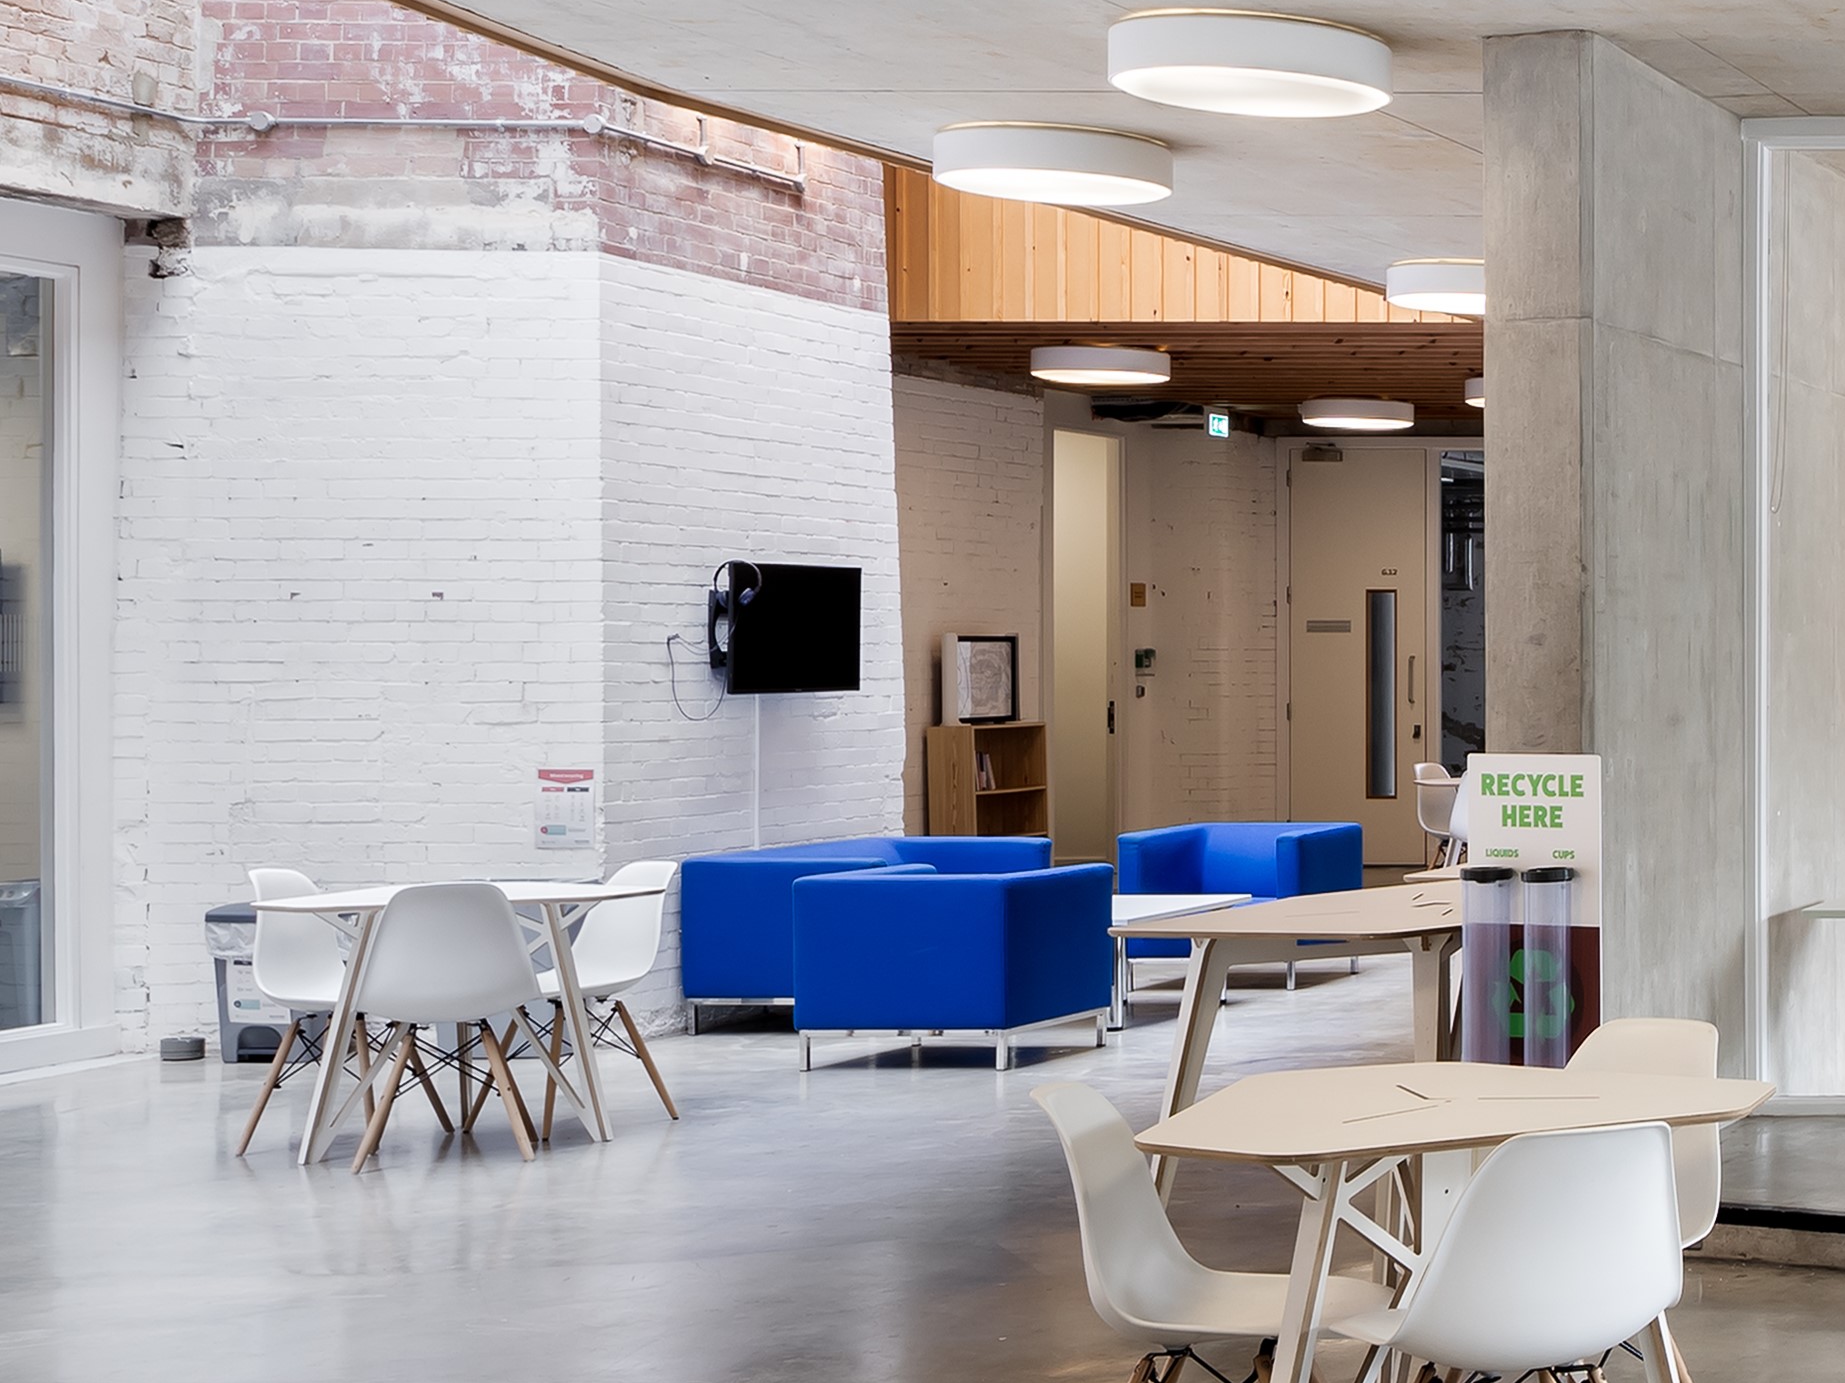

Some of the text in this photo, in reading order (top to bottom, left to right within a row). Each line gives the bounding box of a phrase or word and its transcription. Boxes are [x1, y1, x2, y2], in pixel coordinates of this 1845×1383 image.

[1480, 773, 1585, 798] RECYCLE
[1501, 805, 1564, 828] HERE
[1485, 848, 1519, 859] LIQUIDS
[1552, 849, 1576, 860] CUPS
